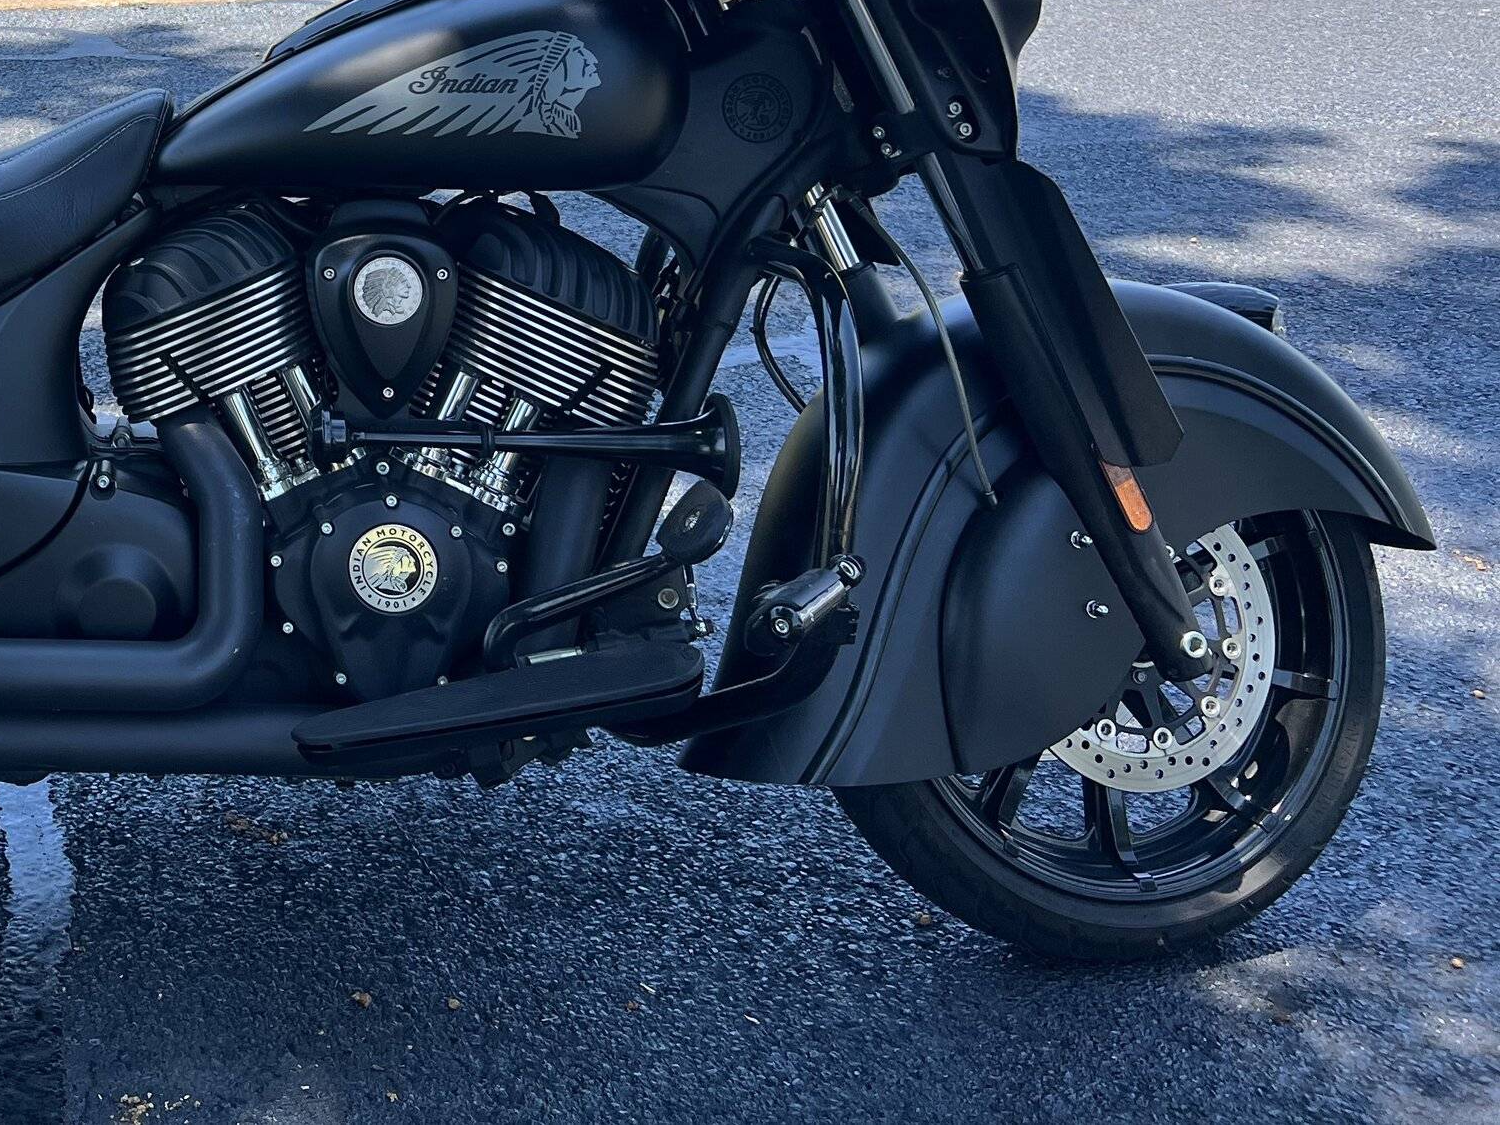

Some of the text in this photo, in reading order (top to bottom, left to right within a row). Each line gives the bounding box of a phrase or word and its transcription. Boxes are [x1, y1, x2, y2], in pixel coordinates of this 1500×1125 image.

[408, 66, 519, 95] Indian
[352, 527, 434, 596] INDIAN MOTORCYCLE
[377, 598, 408, 609] 1901
